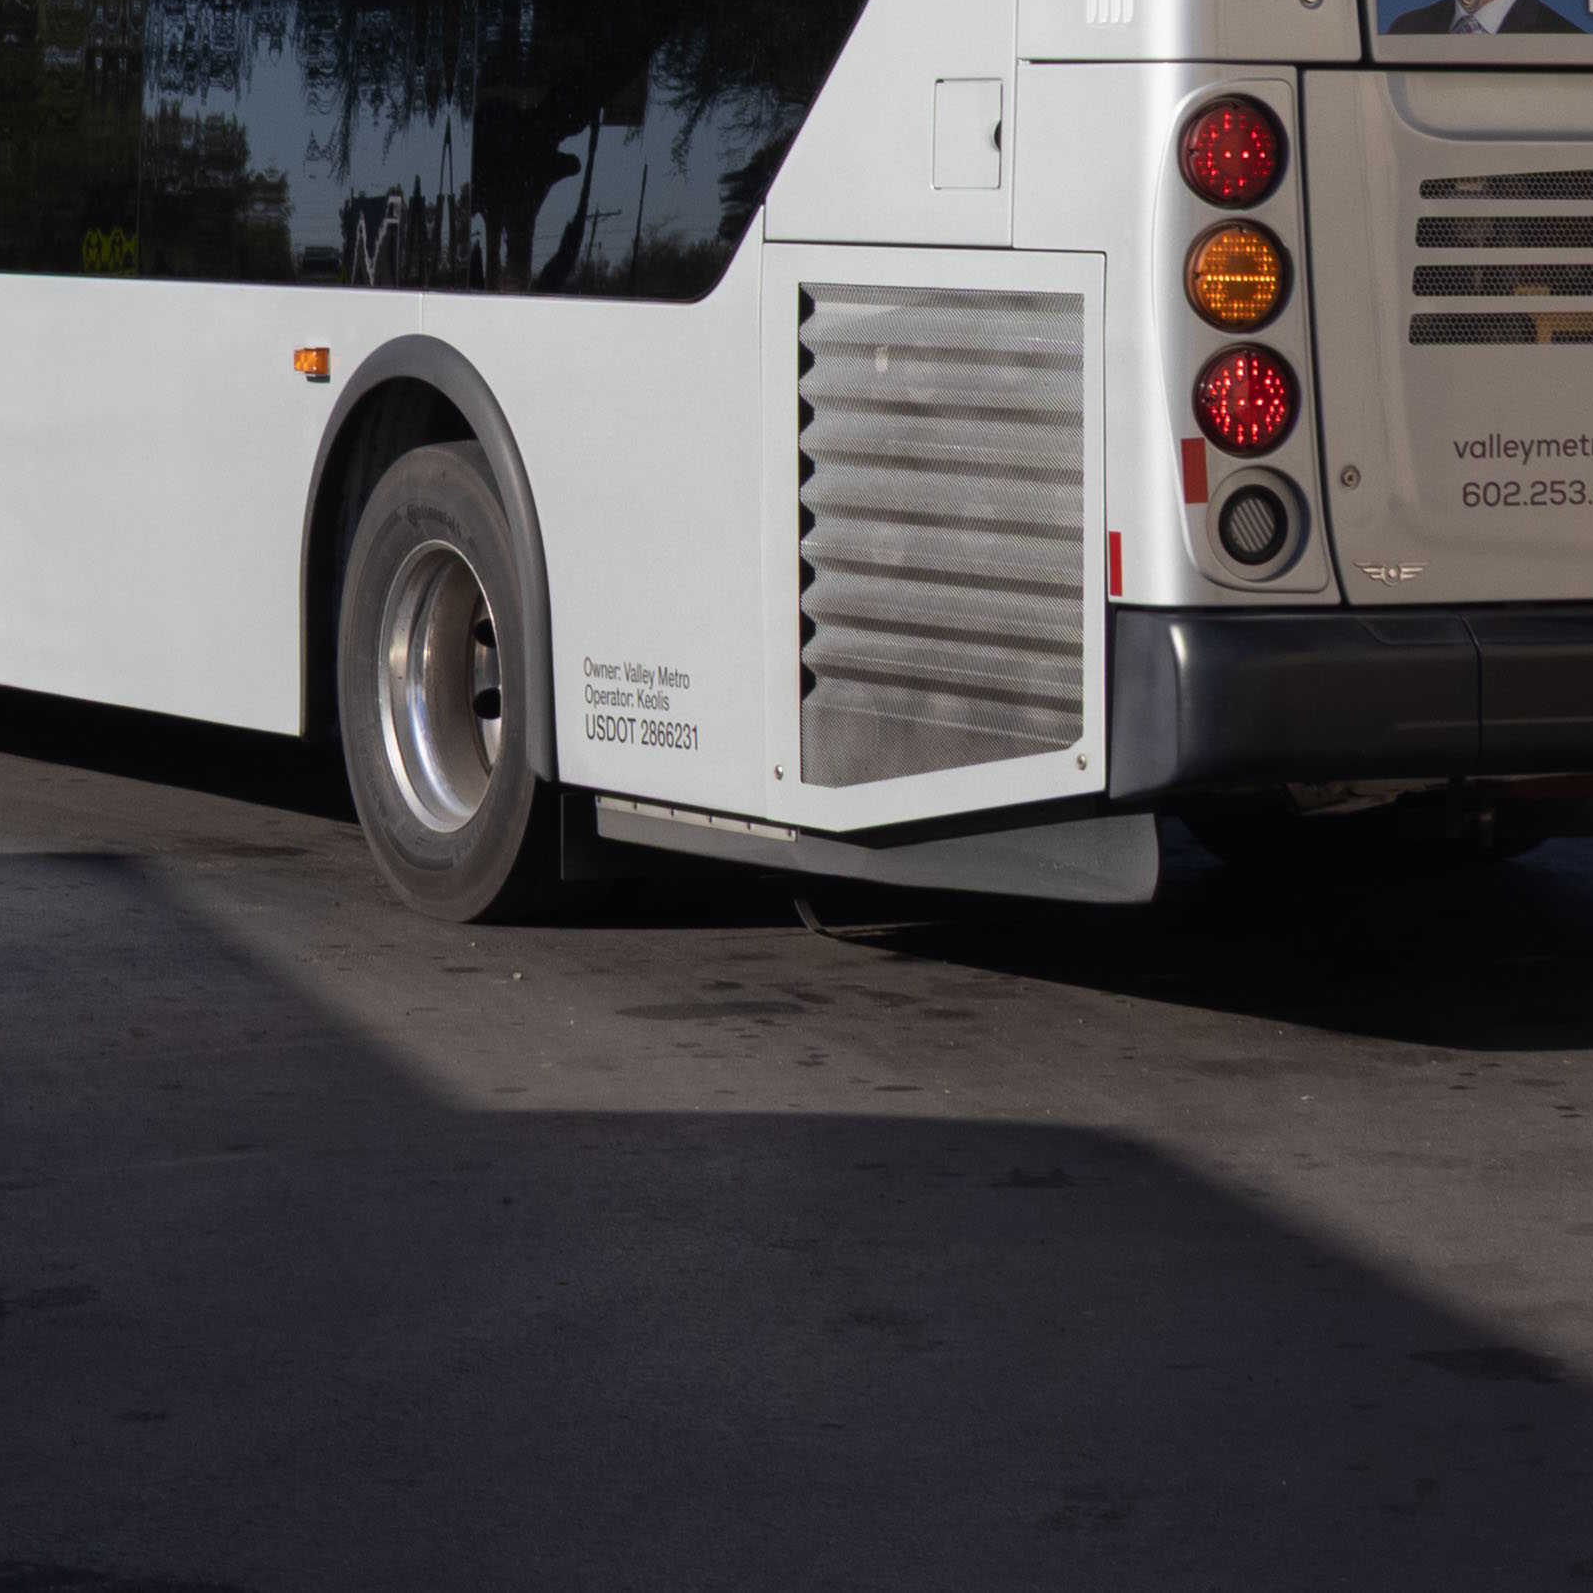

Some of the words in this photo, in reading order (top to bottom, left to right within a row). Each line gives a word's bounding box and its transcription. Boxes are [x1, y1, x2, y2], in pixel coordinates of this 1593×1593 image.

[583, 656, 621, 681] Owner:
[623, 661, 654, 690] Valley
[658, 665, 691, 690] Metro
[585, 684, 634, 708] Operator:
[637, 688, 670, 712] Keolis
[585, 713, 637, 745] USDOT
[640, 718, 698, 751] 2866231
